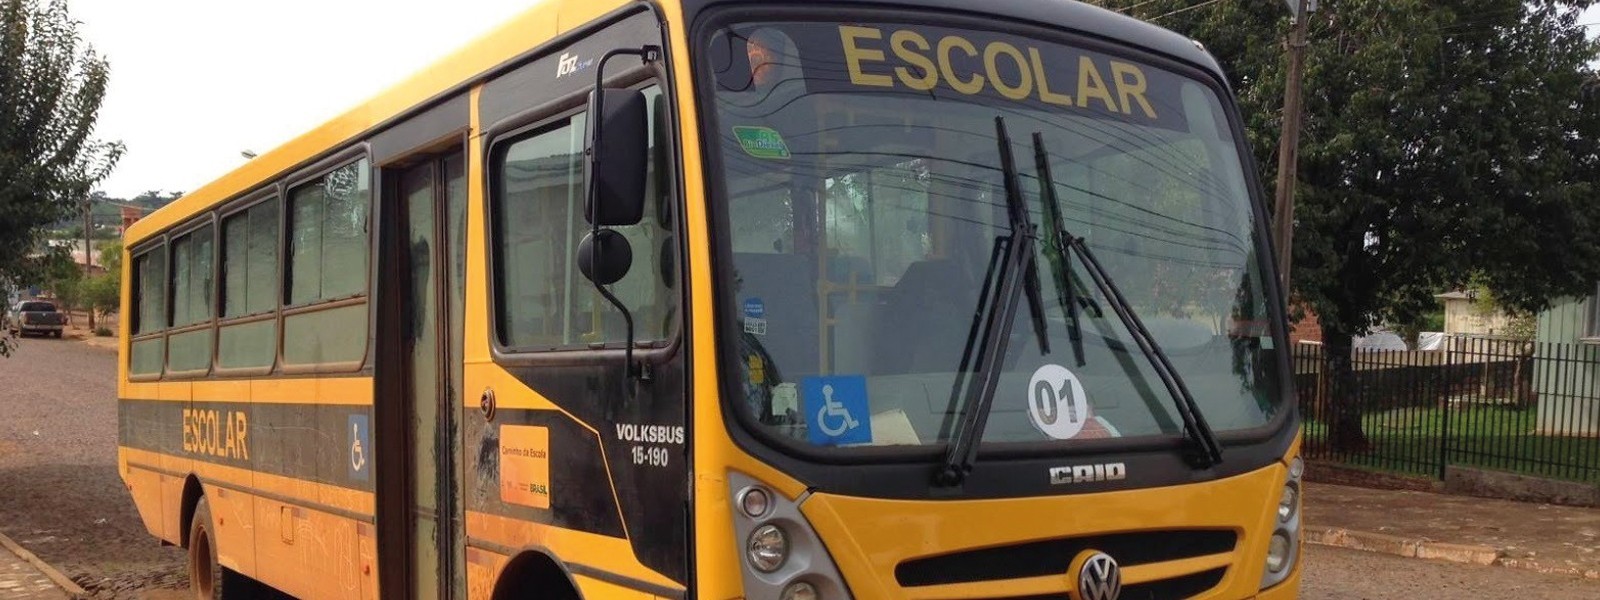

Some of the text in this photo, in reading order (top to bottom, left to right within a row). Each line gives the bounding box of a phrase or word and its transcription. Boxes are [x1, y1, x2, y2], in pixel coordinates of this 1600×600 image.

[838, 25, 1157, 119] ESCOLAR
[1034, 379, 1078, 426] 01
[183, 408, 249, 461] ESCOLAR
[616, 423, 685, 444] VOLKSBUS
[530, 448, 546, 458] Escola
[631, 445, 669, 467] 15-190
[1050, 462, 1126, 485] CAIO
[530, 483, 547, 495] BRASIL
